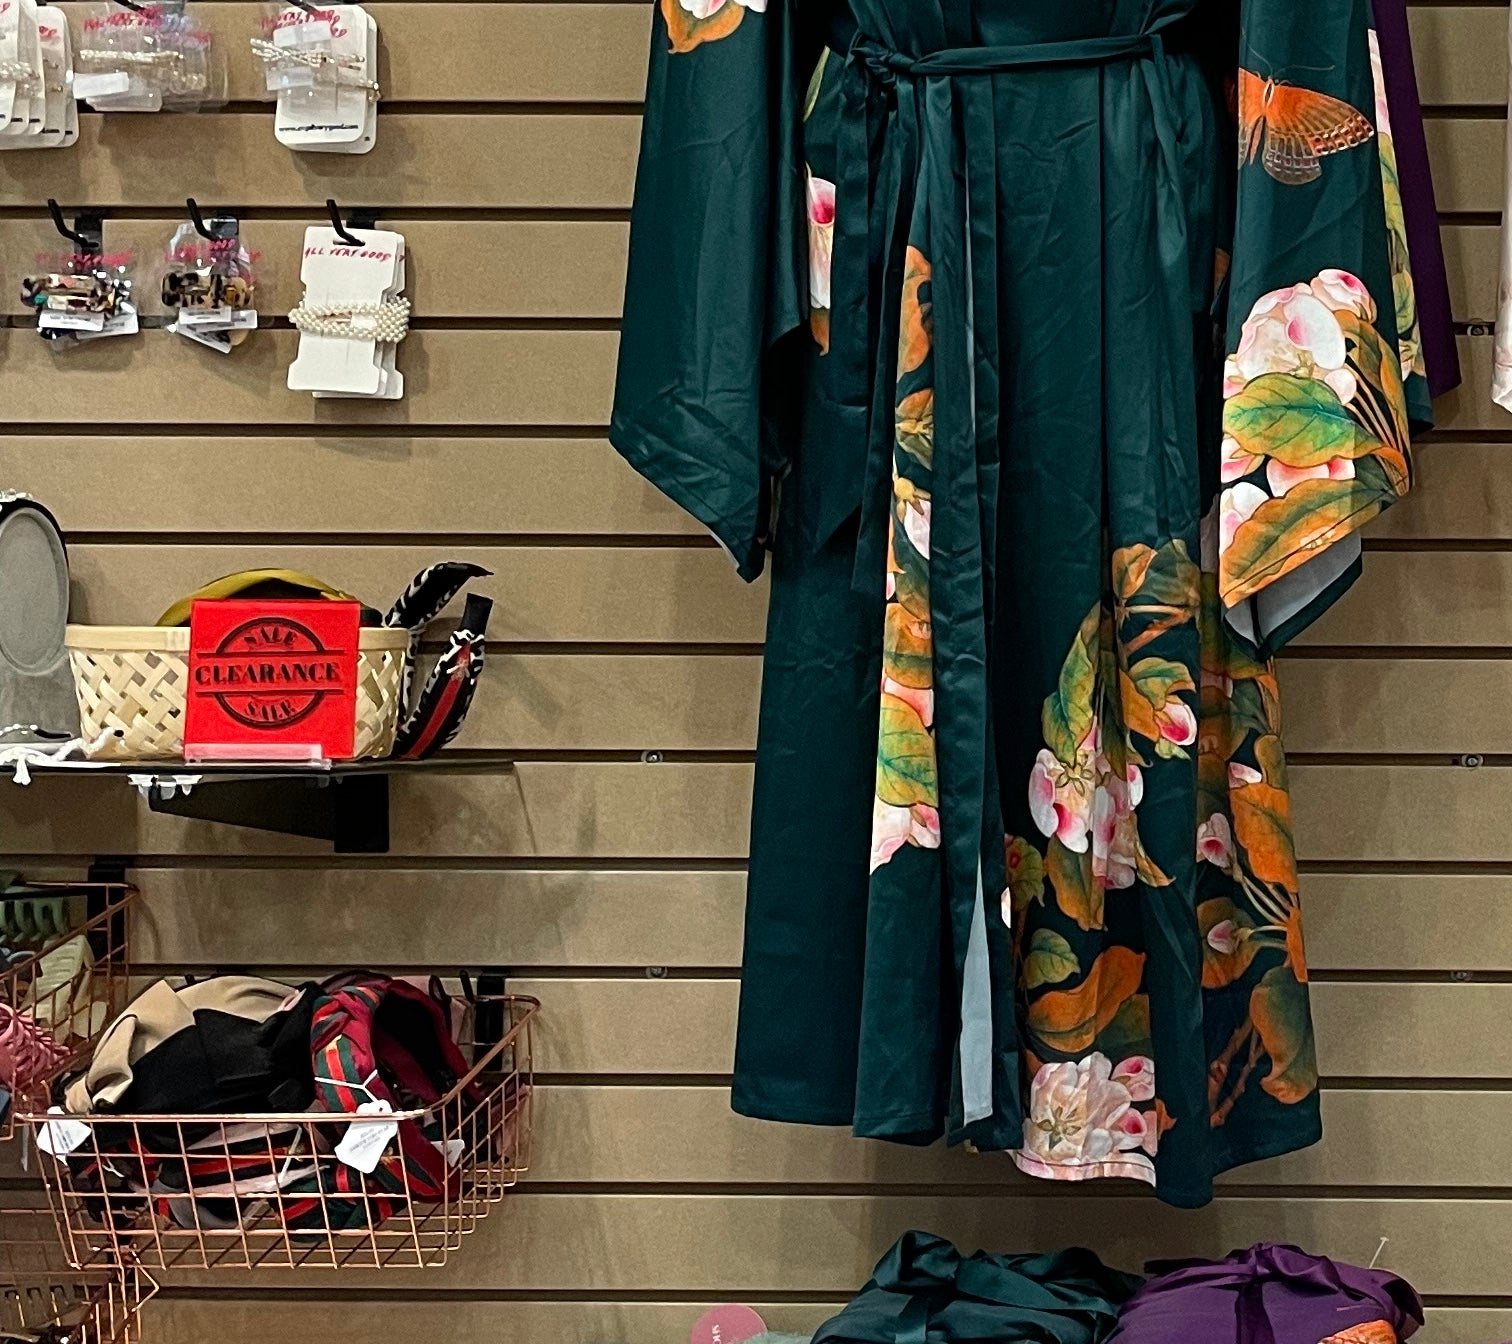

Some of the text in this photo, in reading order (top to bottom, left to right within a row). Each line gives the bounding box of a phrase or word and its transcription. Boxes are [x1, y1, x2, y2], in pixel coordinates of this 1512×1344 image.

[243, 626, 298, 650] SALE
[194, 661, 341, 687] CLEARANCE
[244, 699, 296, 721] SALE
